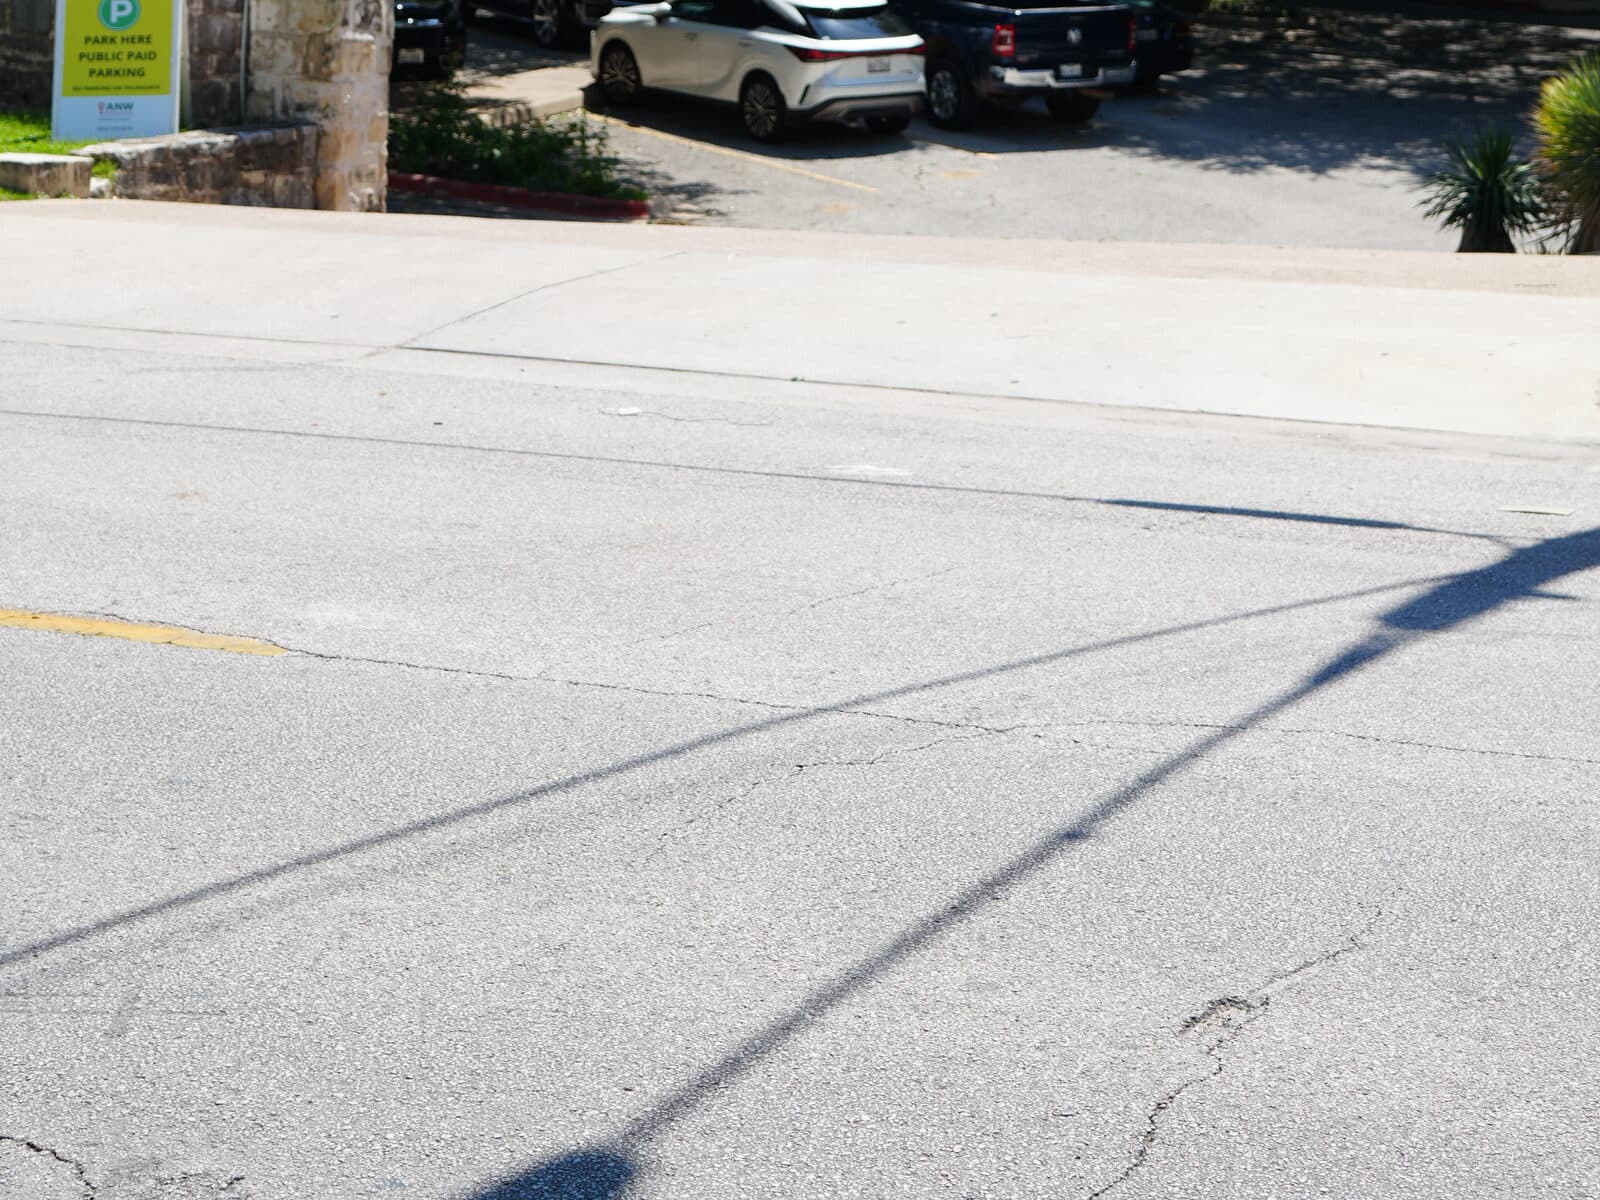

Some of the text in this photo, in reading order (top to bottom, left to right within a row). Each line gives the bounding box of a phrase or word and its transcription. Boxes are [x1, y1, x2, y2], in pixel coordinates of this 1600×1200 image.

[110, 0, 133, 24] P
[84, 34, 153, 45] PARK HERE
[78, 51, 158, 62] PUBLIC PAID
[88, 67, 145, 78] PARKING
